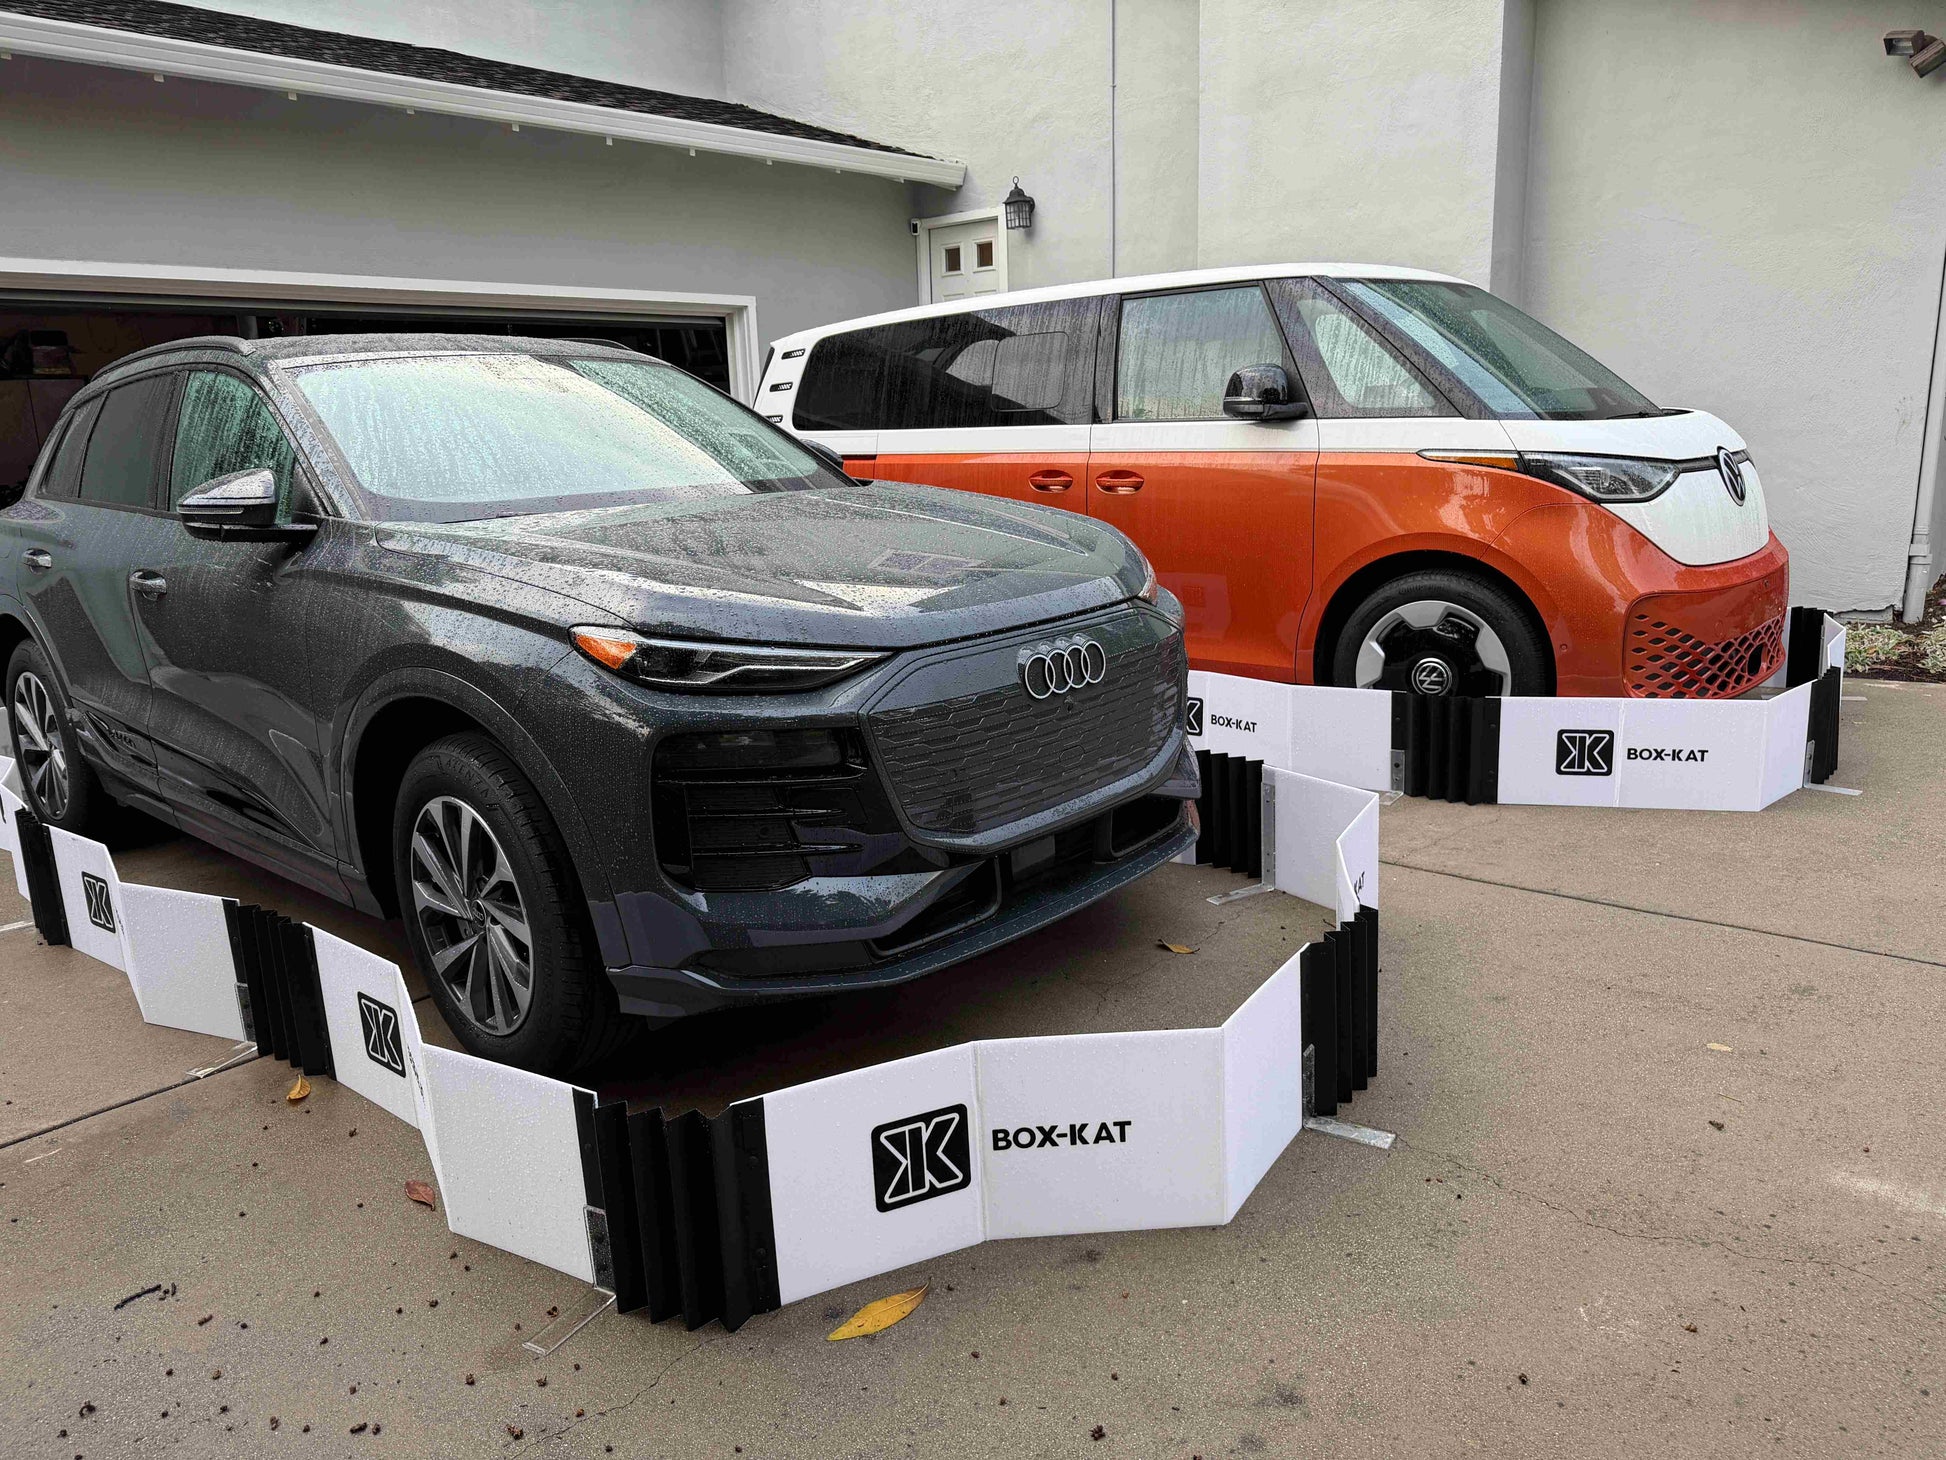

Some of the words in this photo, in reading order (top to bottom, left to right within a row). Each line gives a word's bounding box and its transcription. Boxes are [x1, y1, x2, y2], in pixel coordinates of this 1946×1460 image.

[1211, 714, 1257, 733] BOX-KAT
[1627, 748, 1709, 762] BOX-KAT
[991, 1120, 1132, 1151] BOX-KAT
